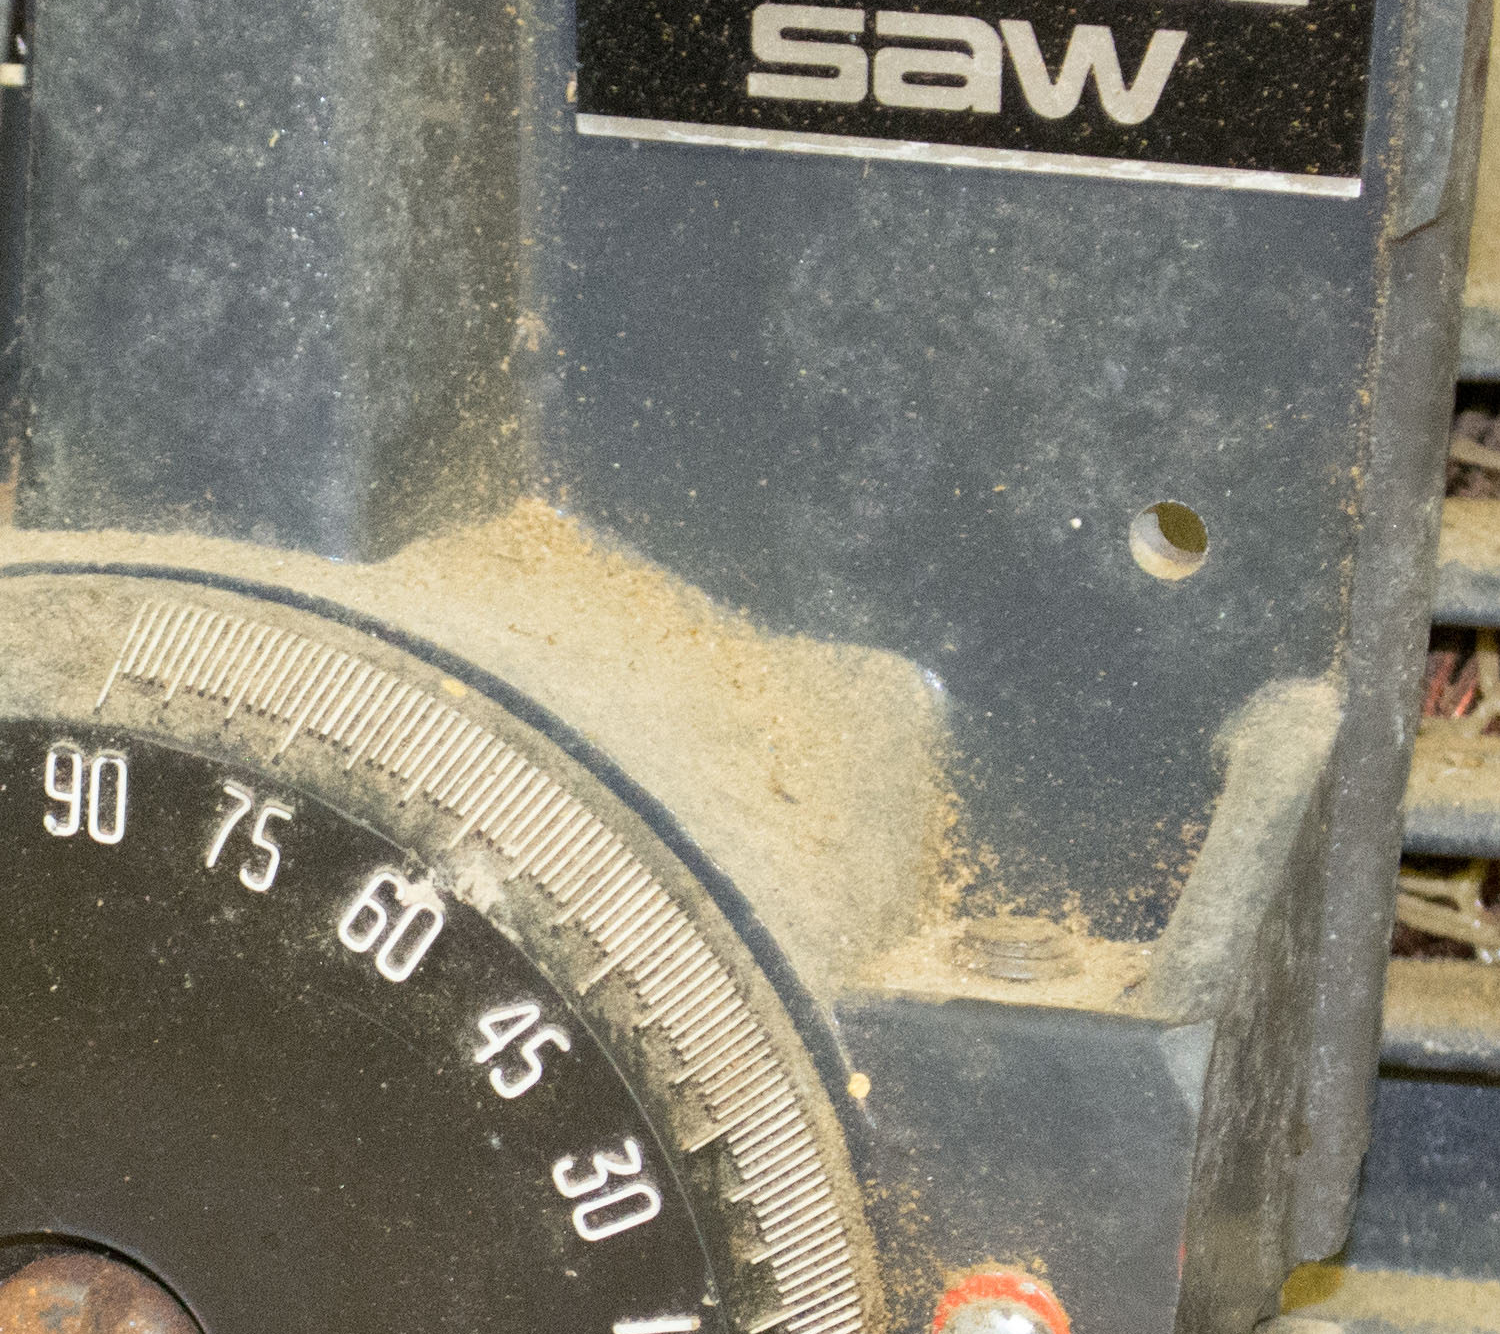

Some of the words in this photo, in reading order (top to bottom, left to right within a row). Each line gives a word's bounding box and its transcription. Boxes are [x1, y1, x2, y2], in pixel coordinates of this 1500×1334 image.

[42, 742, 129, 845] 90
[205, 784, 294, 892] 75
[337, 870, 443, 982] 60
[474, 1001, 571, 1099] 45
[552, 1138, 661, 1242] 30
